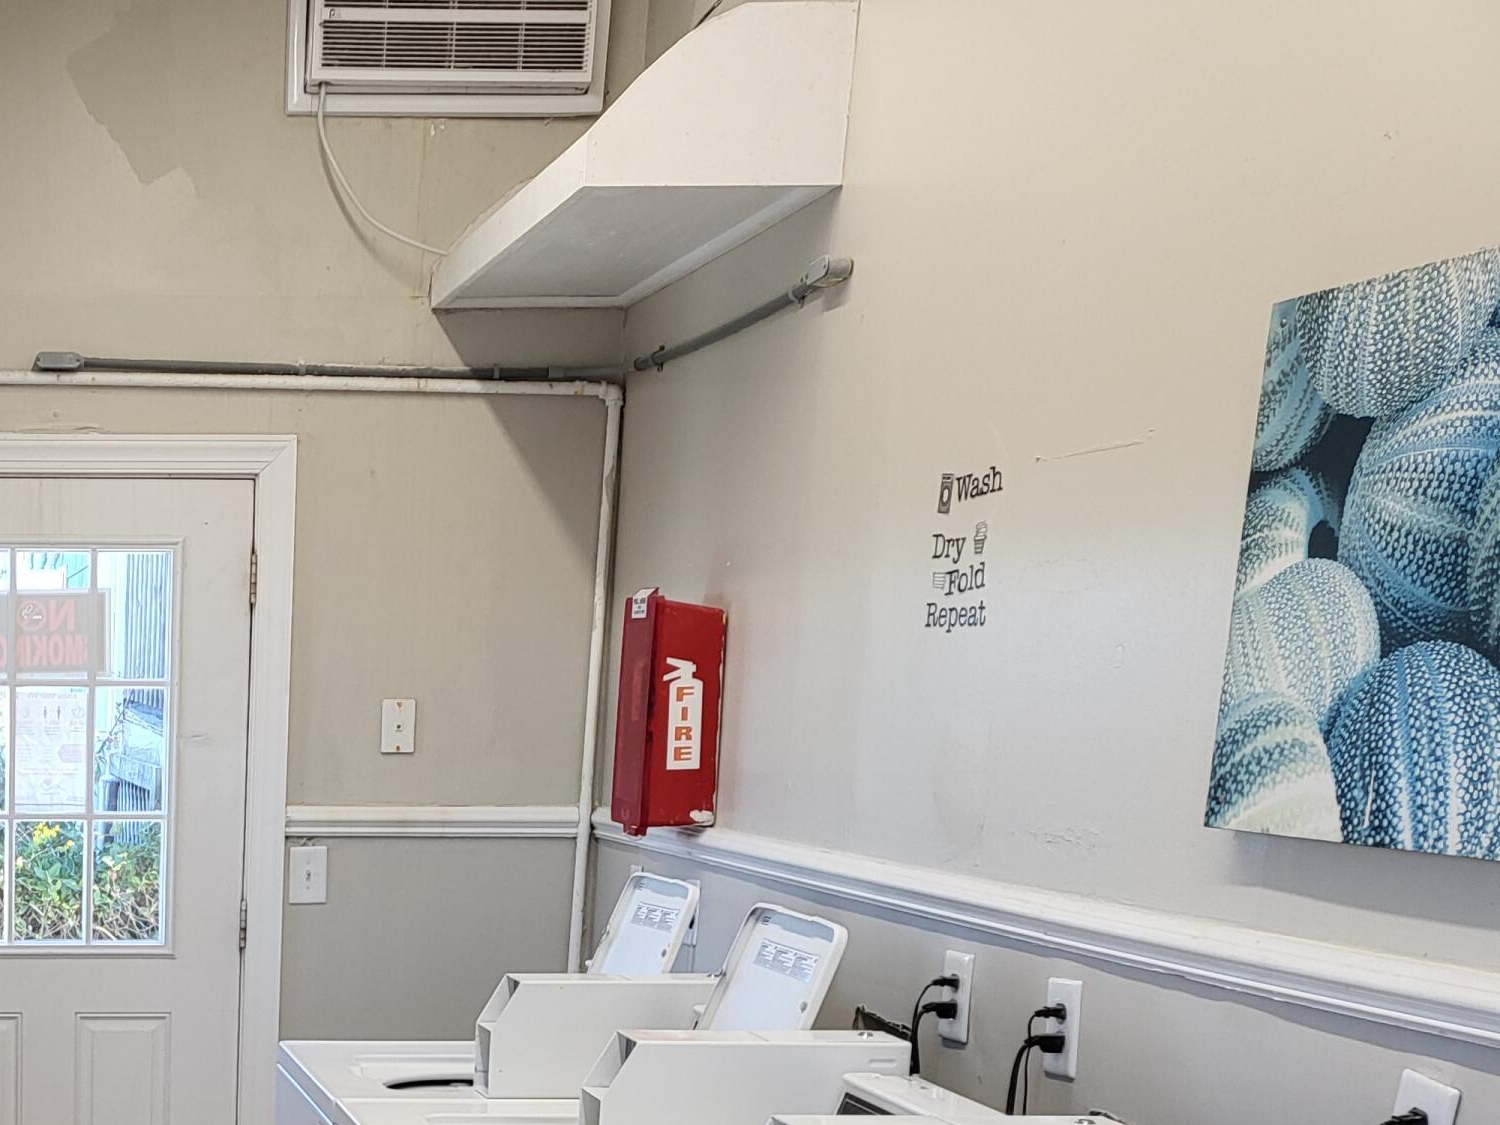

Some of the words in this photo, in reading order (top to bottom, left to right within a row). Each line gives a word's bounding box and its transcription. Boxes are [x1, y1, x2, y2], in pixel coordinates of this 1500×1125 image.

[956, 466, 1003, 502] Wash
[932, 533, 966, 564] Dry
[944, 562, 985, 596] Fold
[925, 600, 986, 633] Repeat
[673, 686, 695, 761] FIRE
